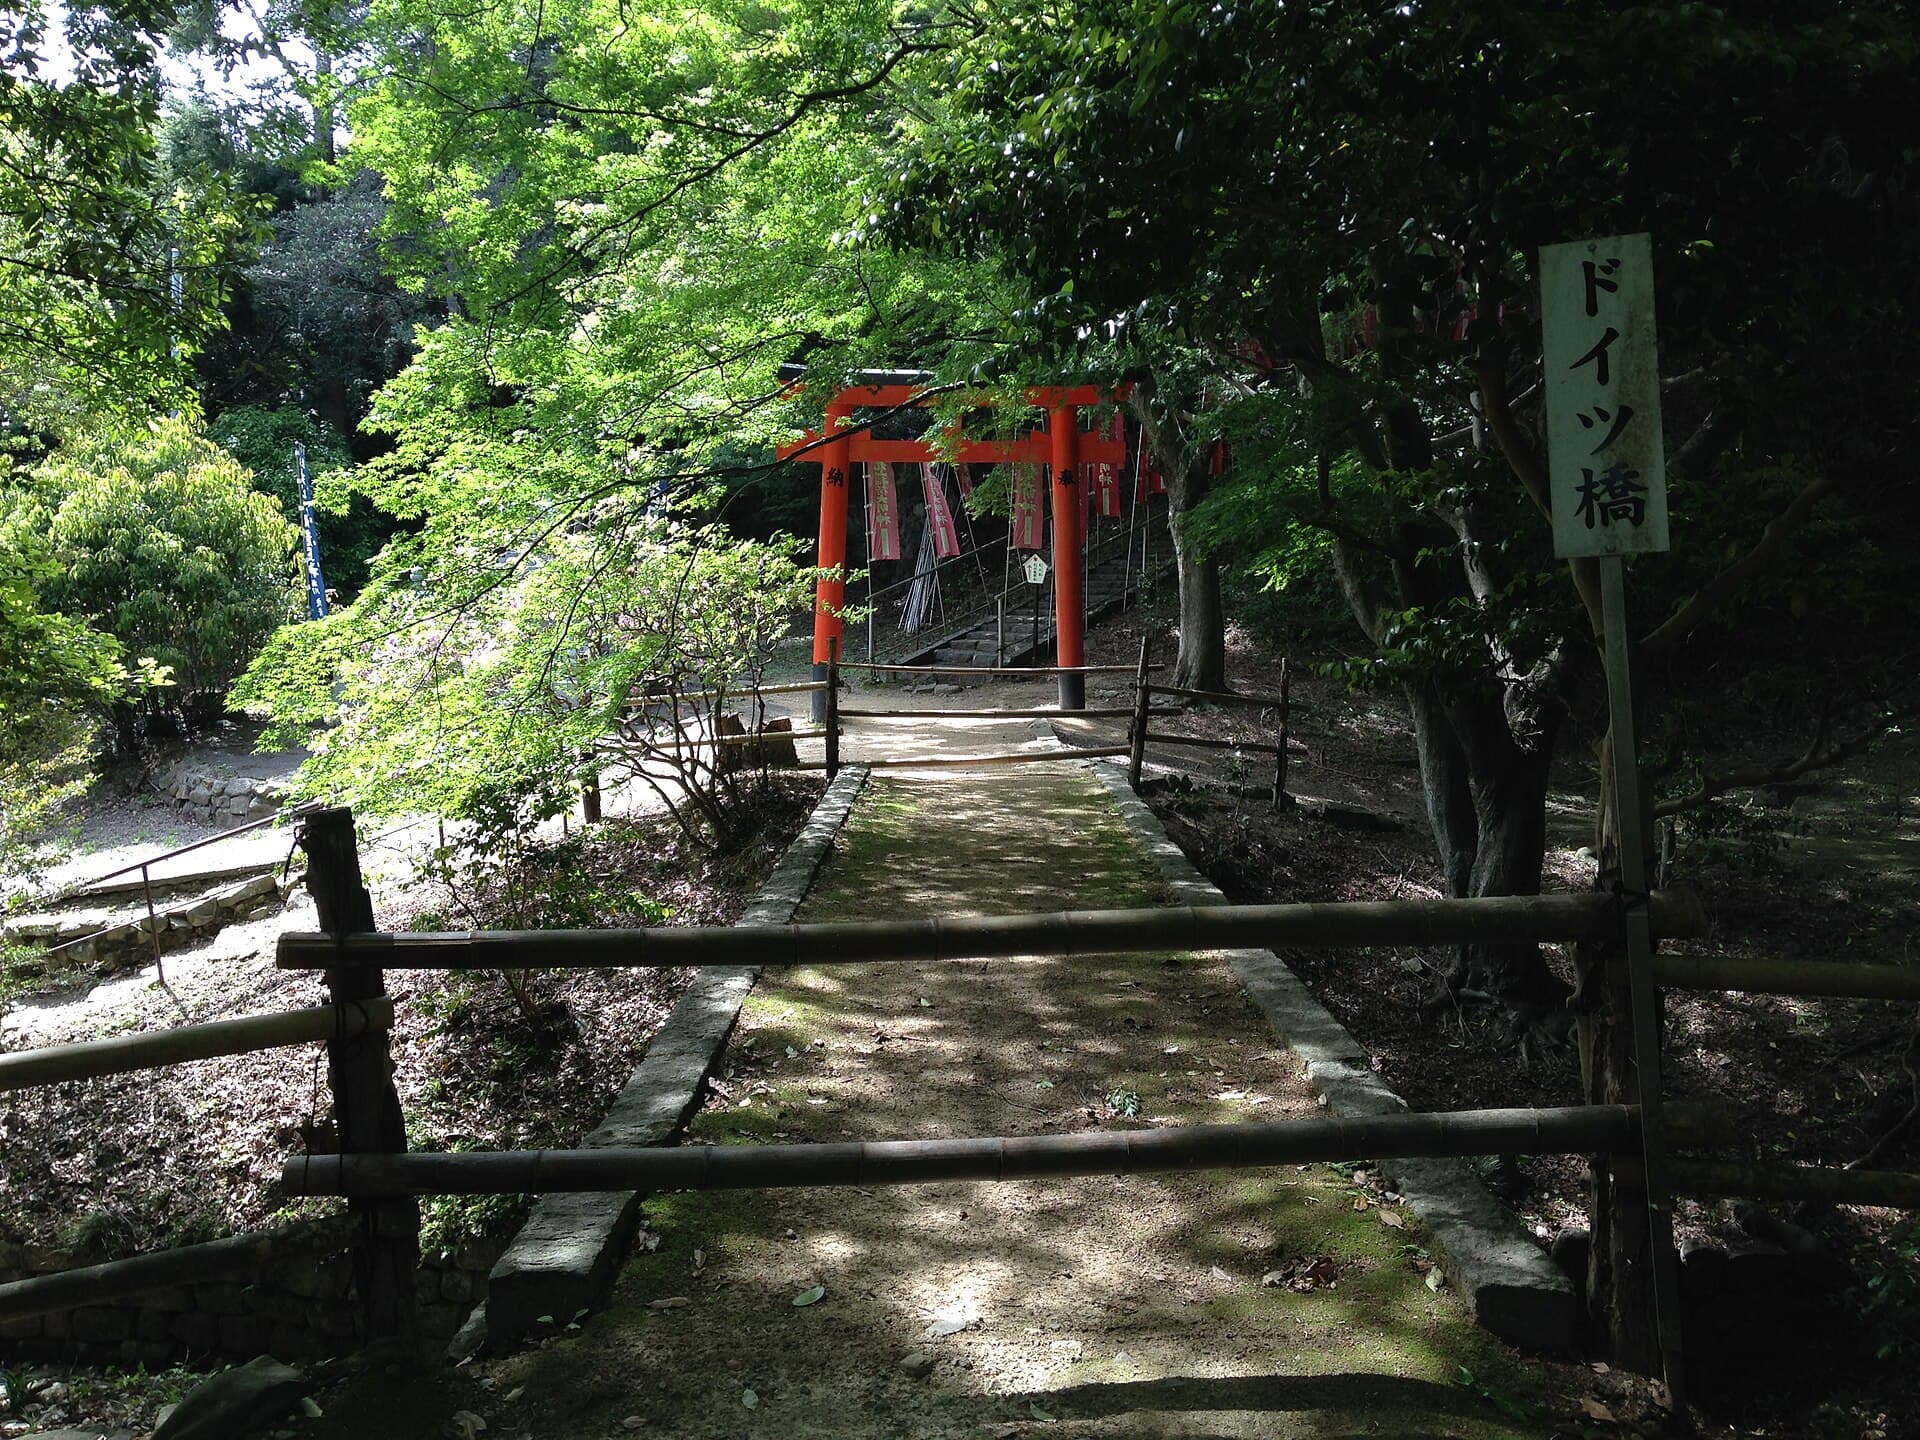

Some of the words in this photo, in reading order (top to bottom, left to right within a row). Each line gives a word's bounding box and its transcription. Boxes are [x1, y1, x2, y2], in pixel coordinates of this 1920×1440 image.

[1569, 257, 1649, 531] ドイツ橋
[826, 466, 844, 488] 納
